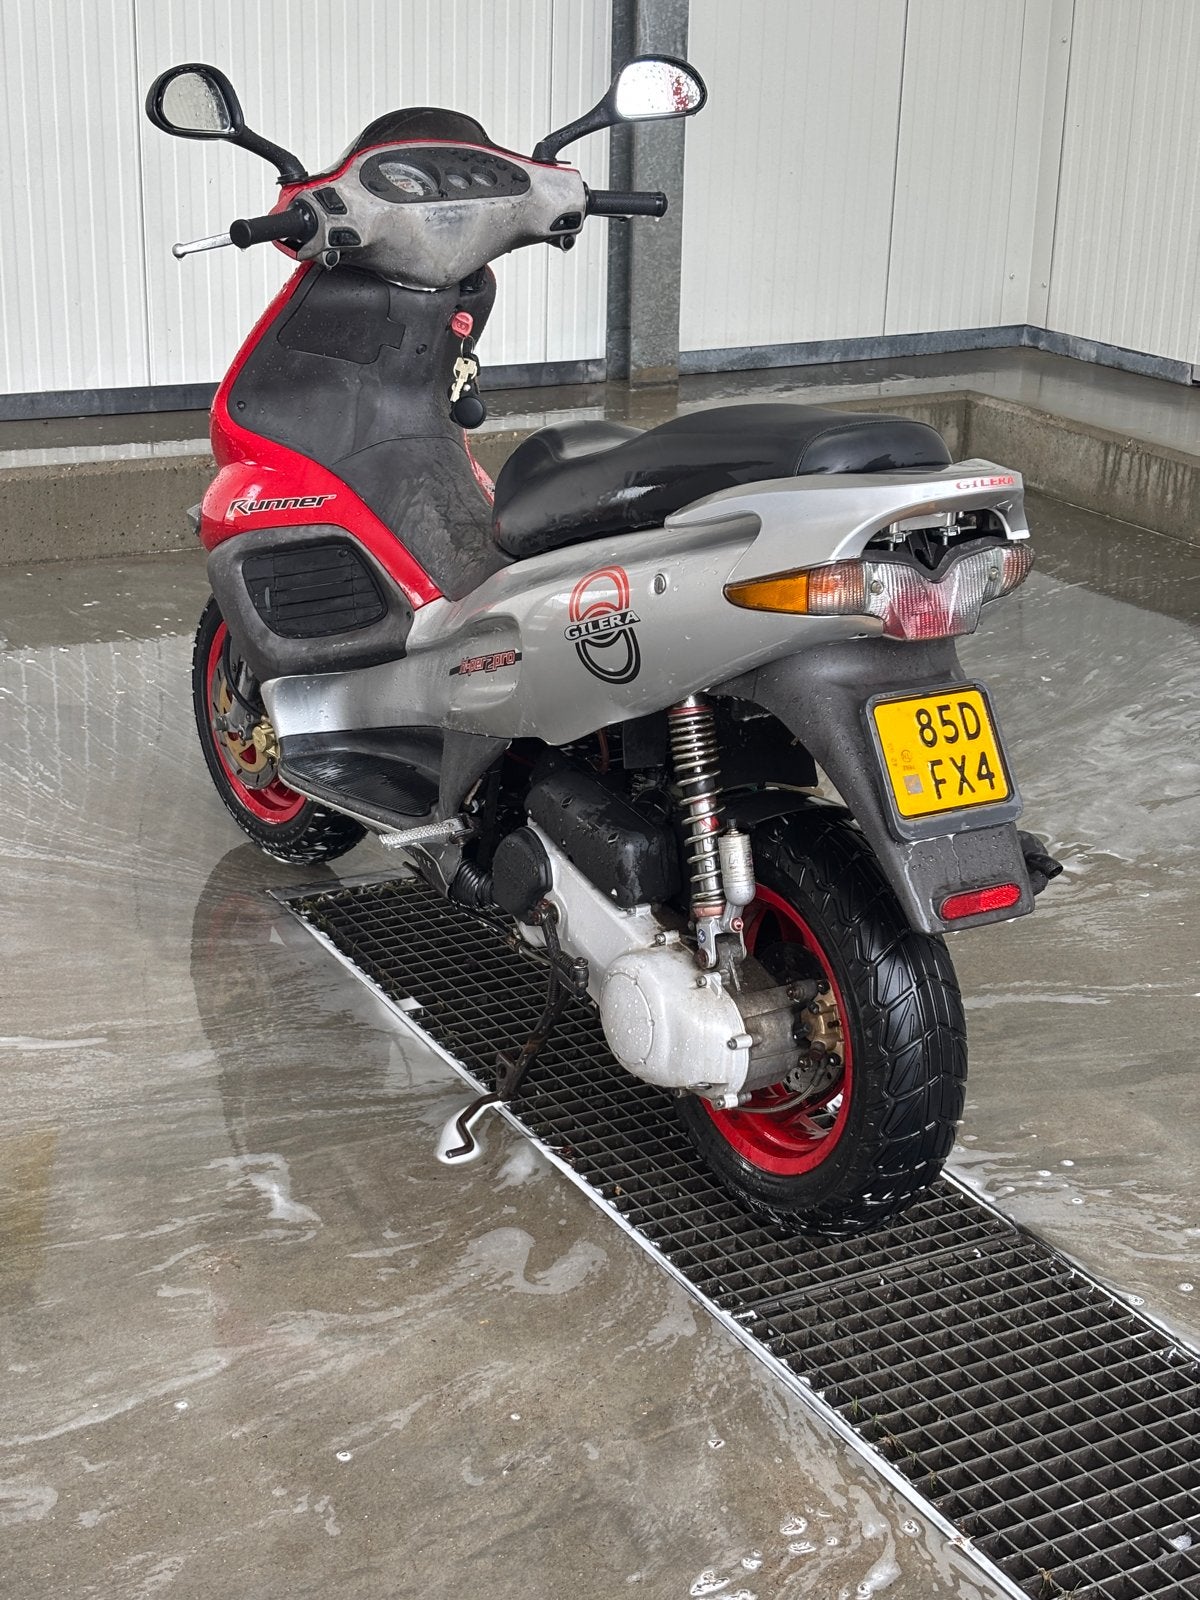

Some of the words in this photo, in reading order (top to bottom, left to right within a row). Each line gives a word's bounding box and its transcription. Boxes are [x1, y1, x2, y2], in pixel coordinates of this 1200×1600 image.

[955, 476, 1015, 490] GILERA
[226, 495, 337, 518] Runner
[564, 610, 640, 641] GILERA
[915, 701, 982, 748] 85D
[929, 751, 996, 800] FX4
